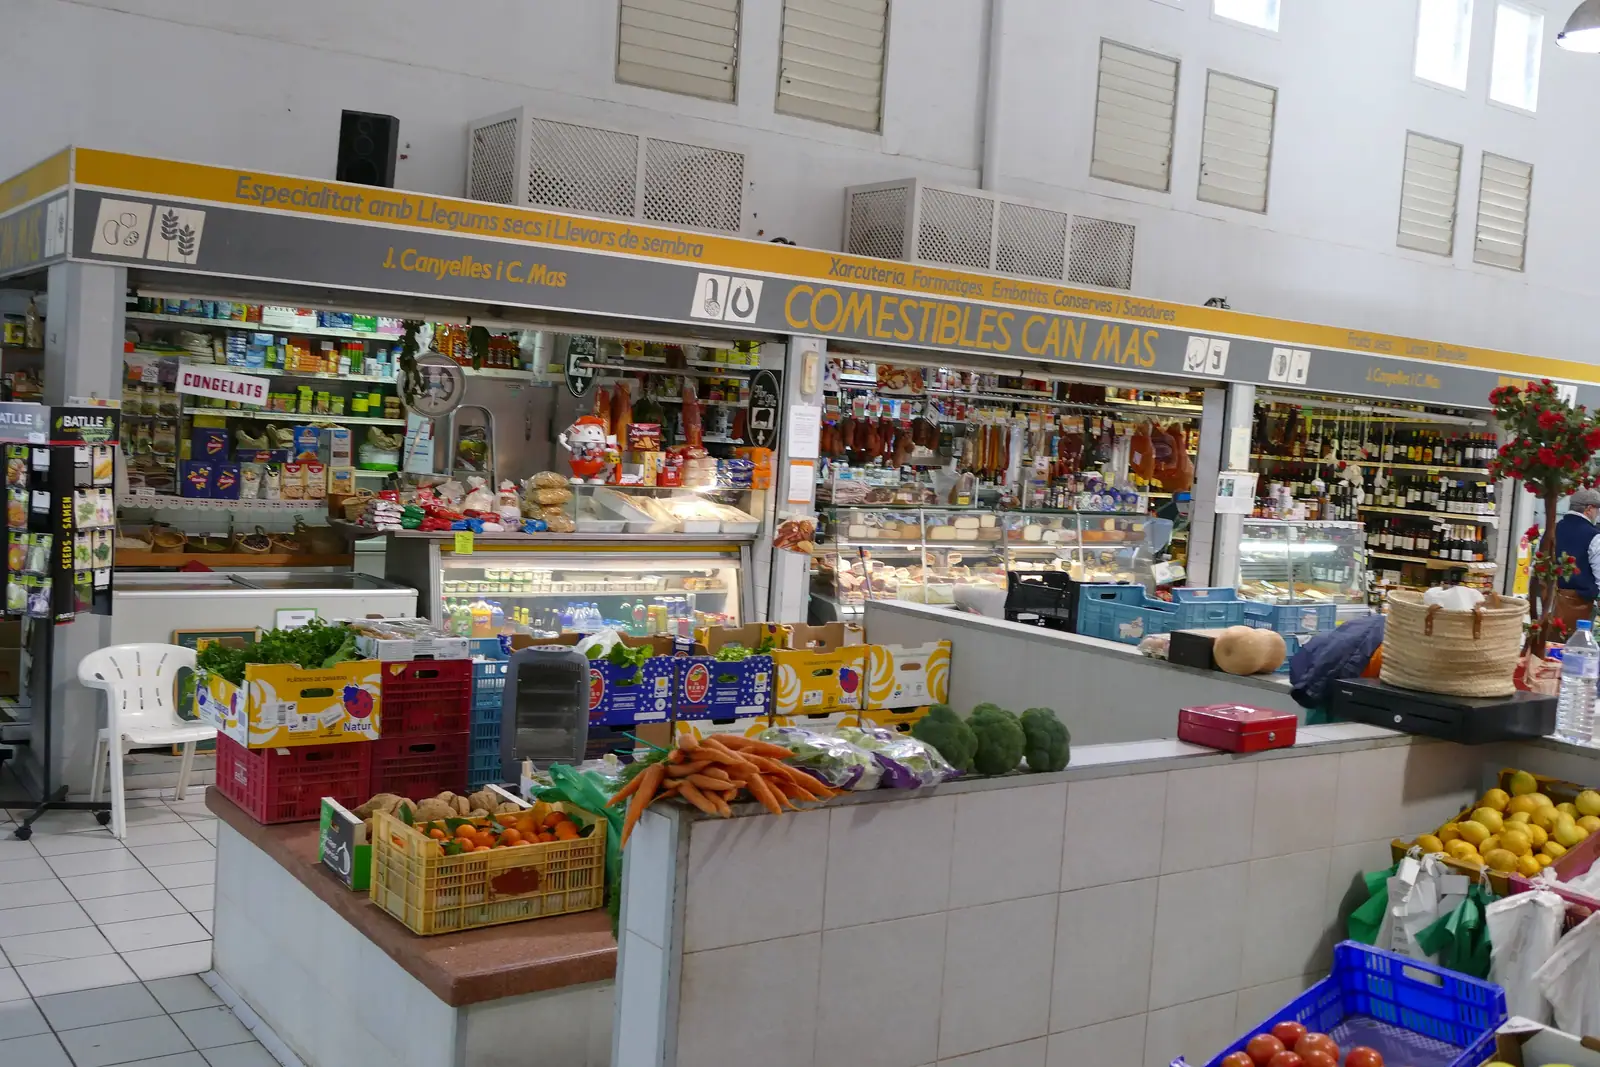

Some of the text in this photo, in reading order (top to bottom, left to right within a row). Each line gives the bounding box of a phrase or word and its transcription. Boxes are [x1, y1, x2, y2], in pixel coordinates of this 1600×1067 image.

[236, 175, 704, 258] Especialitat amb Llegums secs i Llevors de sembra
[383, 246, 569, 288] J. Canyelles i C. Mas
[1053, 289, 1113, 313] Conserves
[1123, 300, 1176, 322] Saladures
[784, 284, 1015, 352] COMESTIBLES
[1091, 323, 1160, 368] MAS
[183, 372, 263, 398] CONGELATS
[63, 415, 104, 428] BATLLE
[62, 496, 72, 529] SAMEN
[62, 540, 72, 570] SEEDS
[343, 721, 373, 732] Natur
